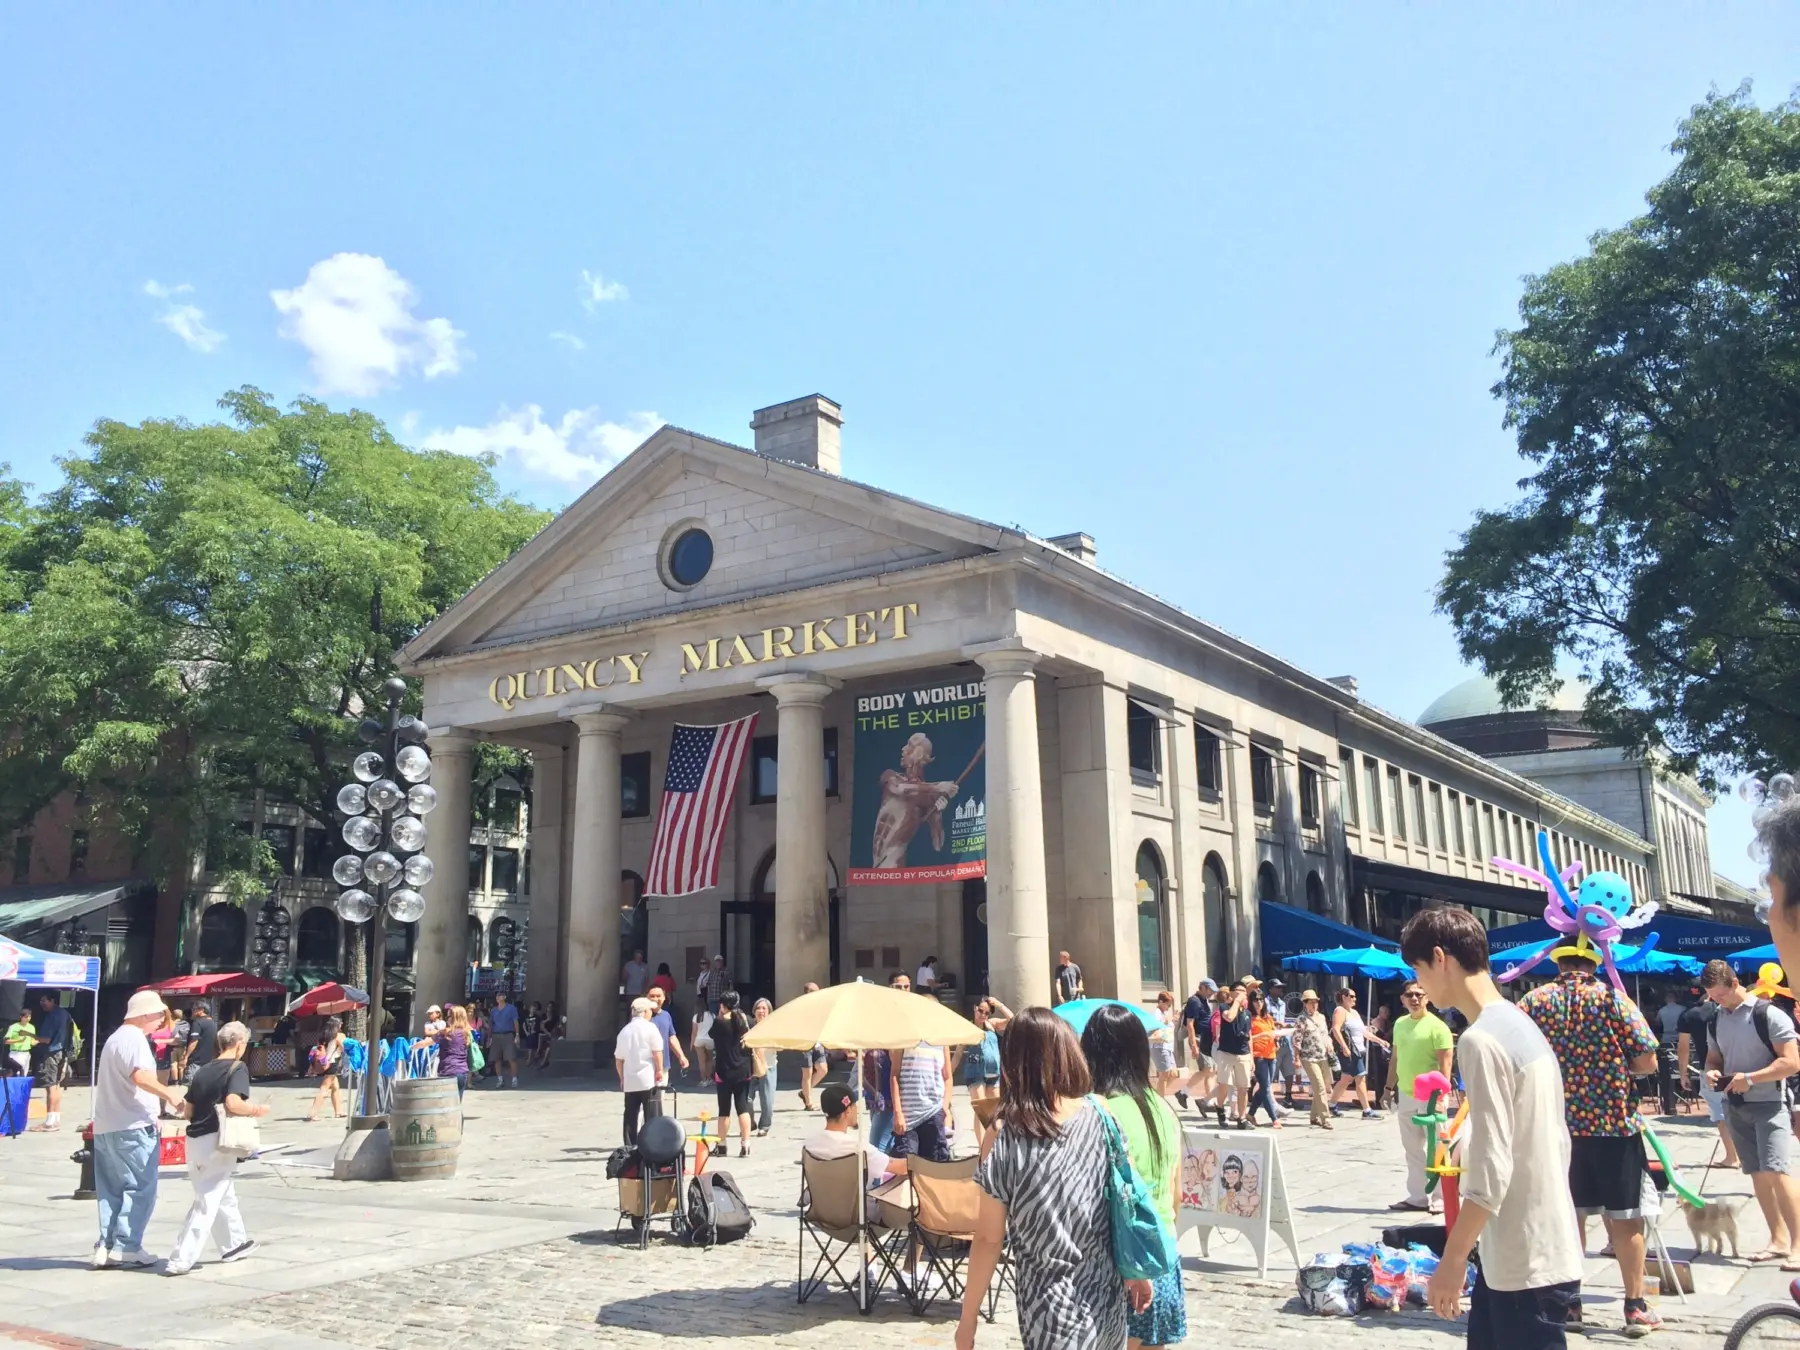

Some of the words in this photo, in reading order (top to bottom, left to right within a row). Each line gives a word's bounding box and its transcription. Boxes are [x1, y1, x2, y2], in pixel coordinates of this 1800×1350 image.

[488, 651, 650, 711] QUINCY
[680, 603, 920, 675] MARKET
[858, 692, 906, 712] BODY
[857, 713, 900, 732] THE
[951, 838, 966, 848] 2ND
[852, 871, 901, 880] EXTENDED
[903, 871, 916, 880] BY
[918, 869, 956, 879] POPULAR
[957, 864, 985, 876] DEMAND
[1678, 936, 1709, 945] GREAT
[1713, 935, 1752, 945] STEAKS
[224, 986, 246, 994] England
